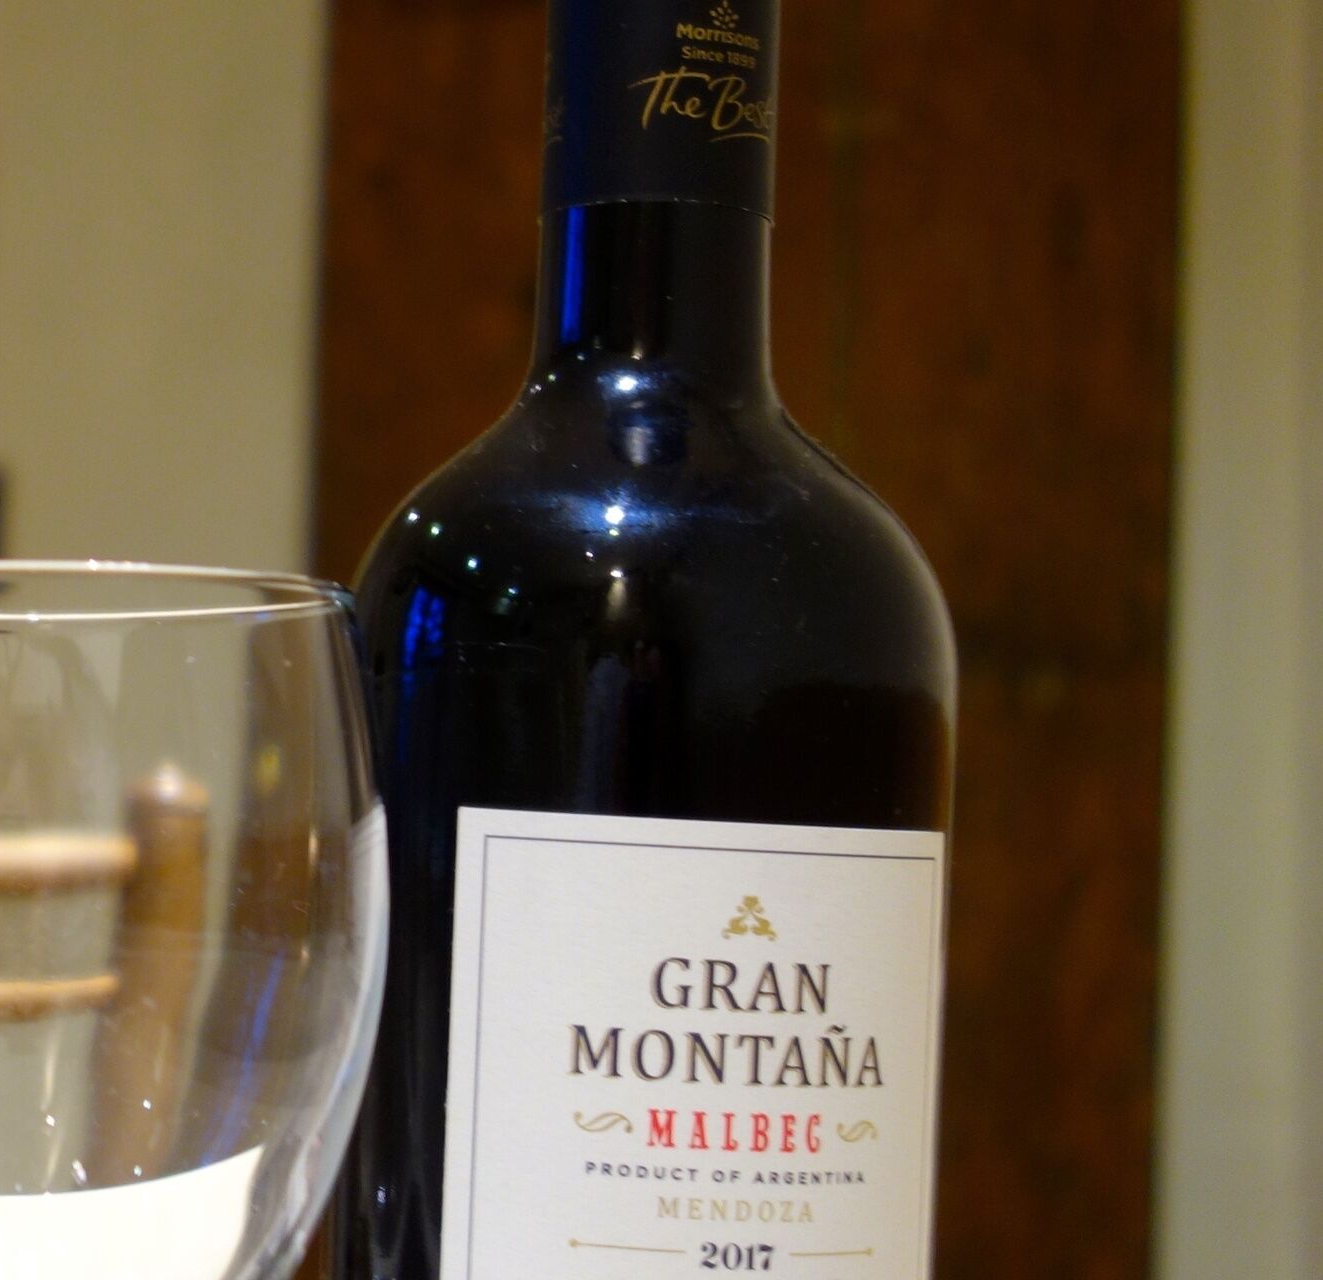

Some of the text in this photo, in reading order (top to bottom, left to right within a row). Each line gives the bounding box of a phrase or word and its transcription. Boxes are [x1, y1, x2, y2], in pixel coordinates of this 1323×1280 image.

[675, 22, 761, 51] Morrisons
[681, 45, 724, 63] Since
[627, 66, 710, 130] The
[650, 956, 832, 1015] GRAN
[567, 1023, 886, 1088] MONTAÑA
[646, 1108, 823, 1154] MALBEC
[585, 1161, 866, 1187] PRODUCT OF ARGENTINA
[656, 1195, 815, 1224] MENDOZA
[699, 1241, 776, 1272] 2017
